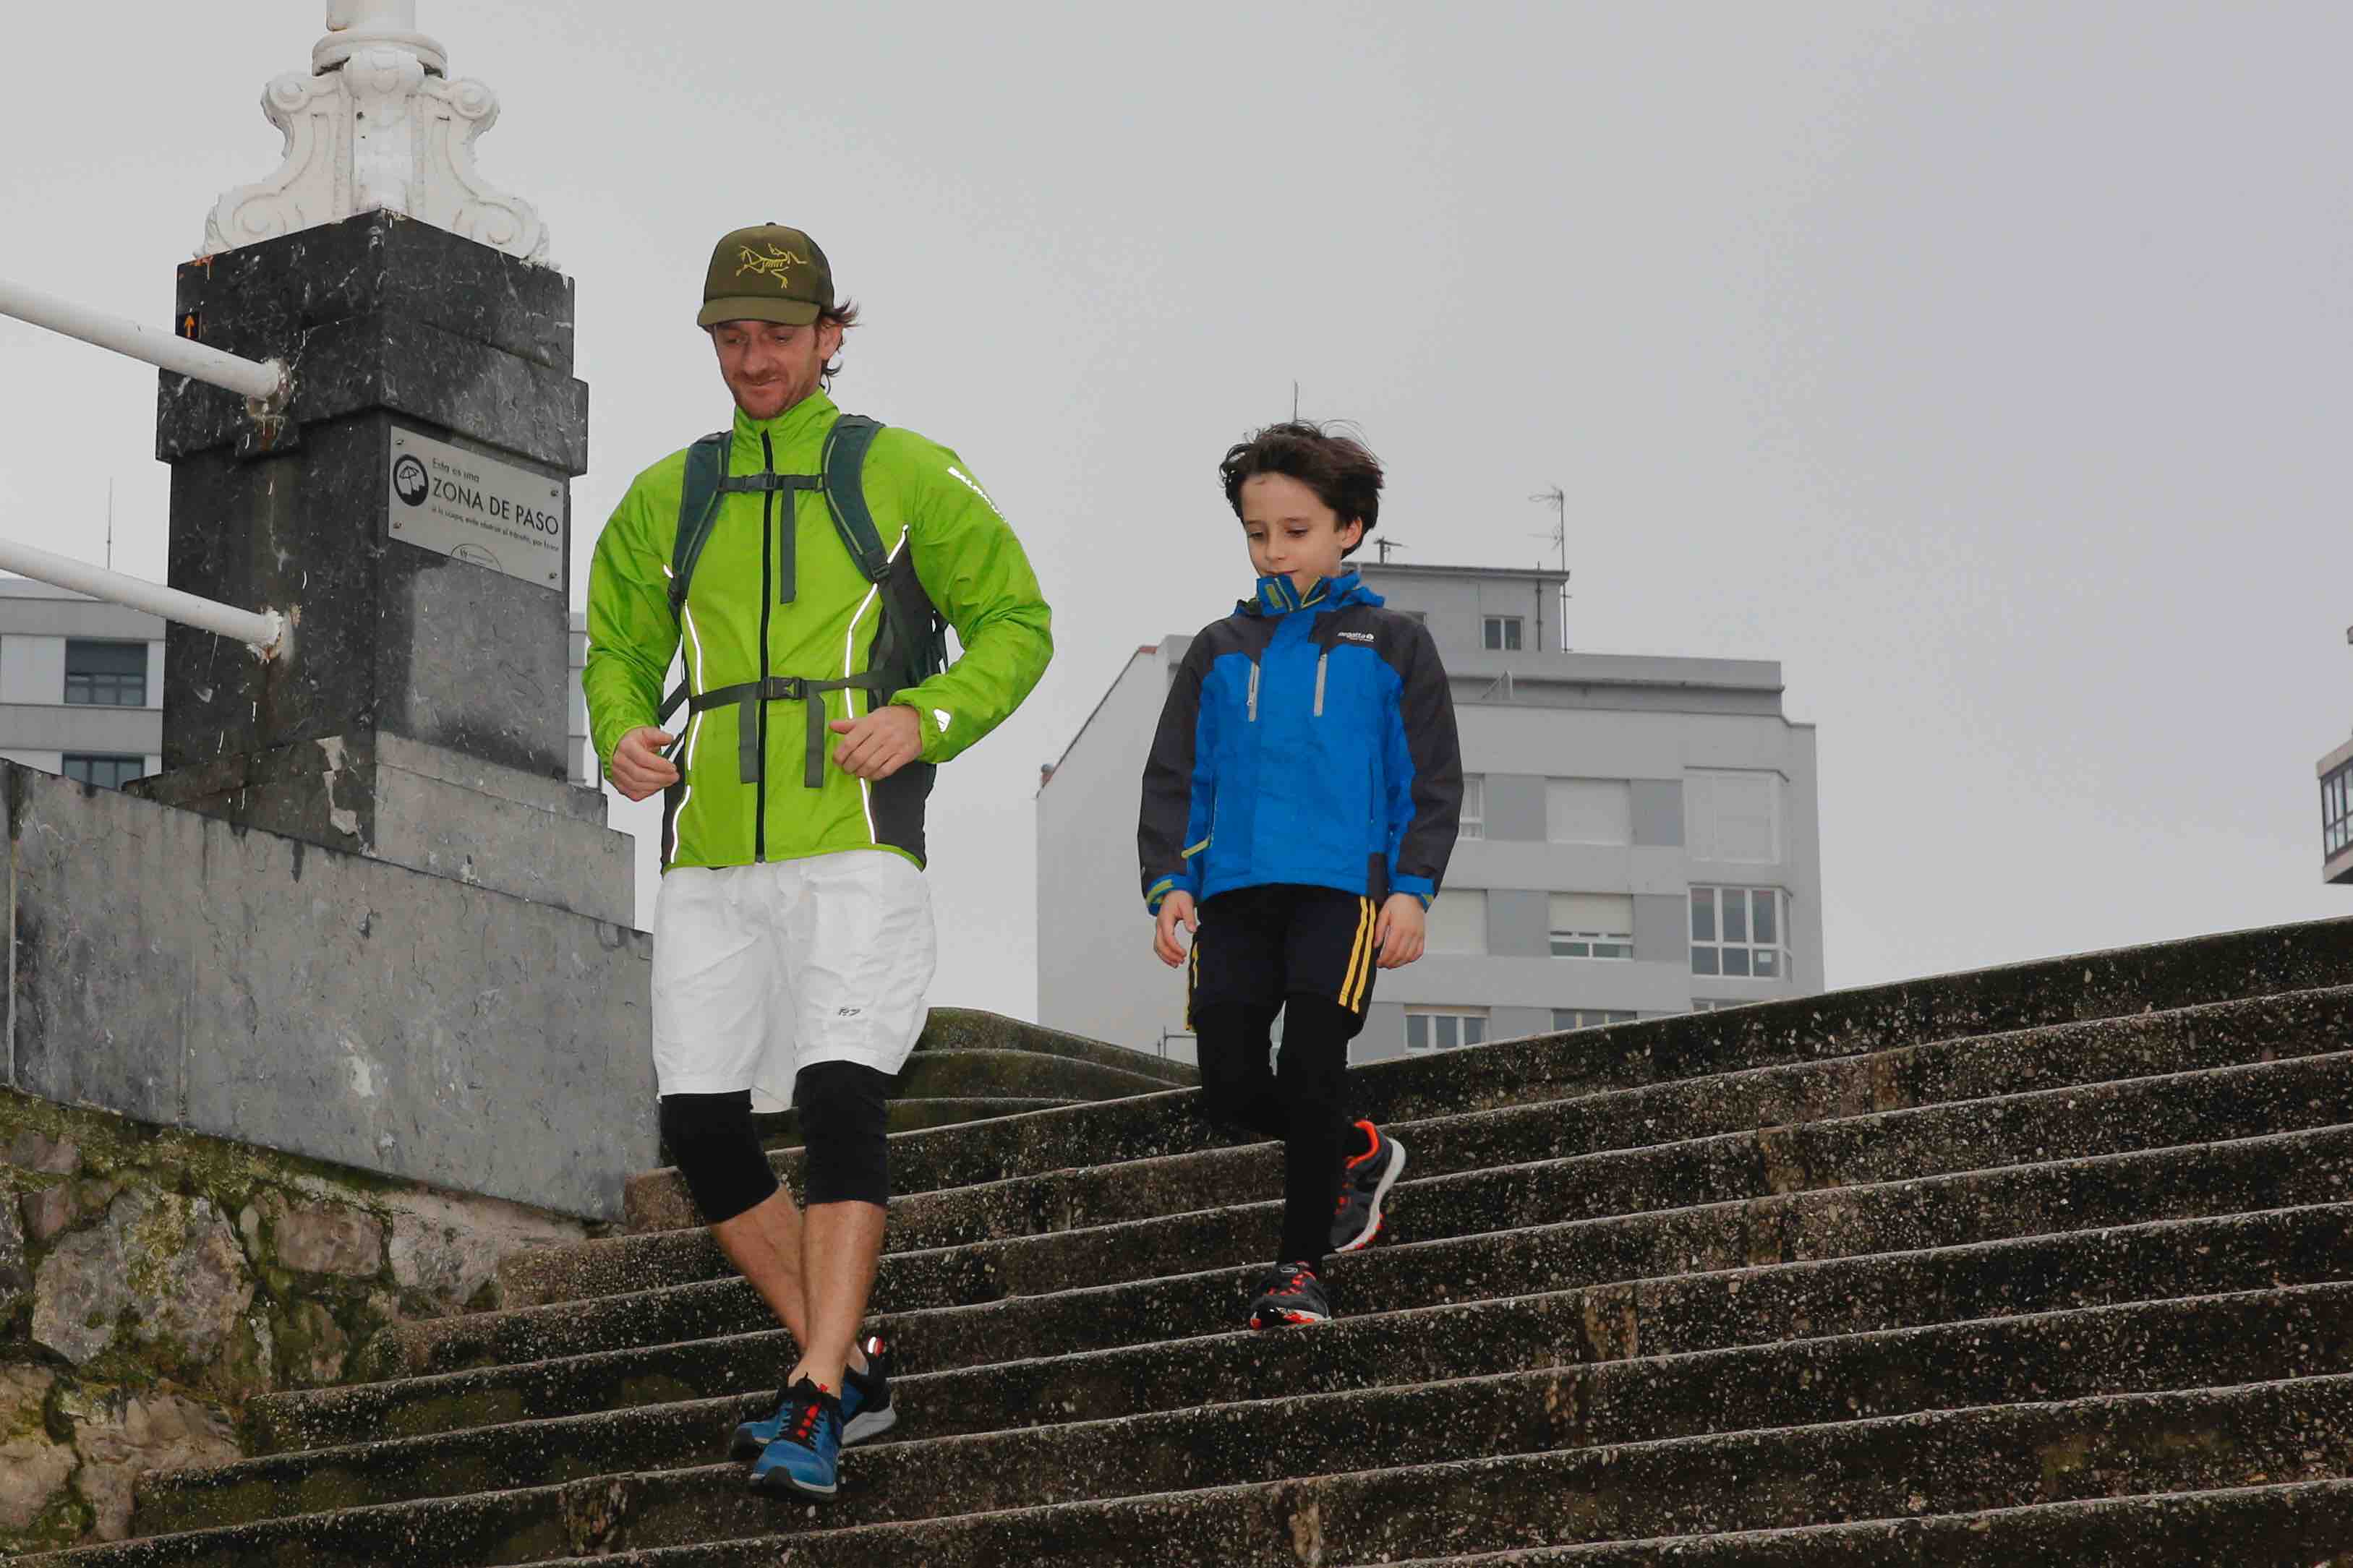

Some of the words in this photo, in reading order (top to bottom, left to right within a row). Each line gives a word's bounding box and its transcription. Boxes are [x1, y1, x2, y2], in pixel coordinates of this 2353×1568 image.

[464, 472, 479, 483] una
[433, 477, 483, 511] ZONA
[490, 496, 509, 520] DE
[516, 505, 558, 535] PASO
